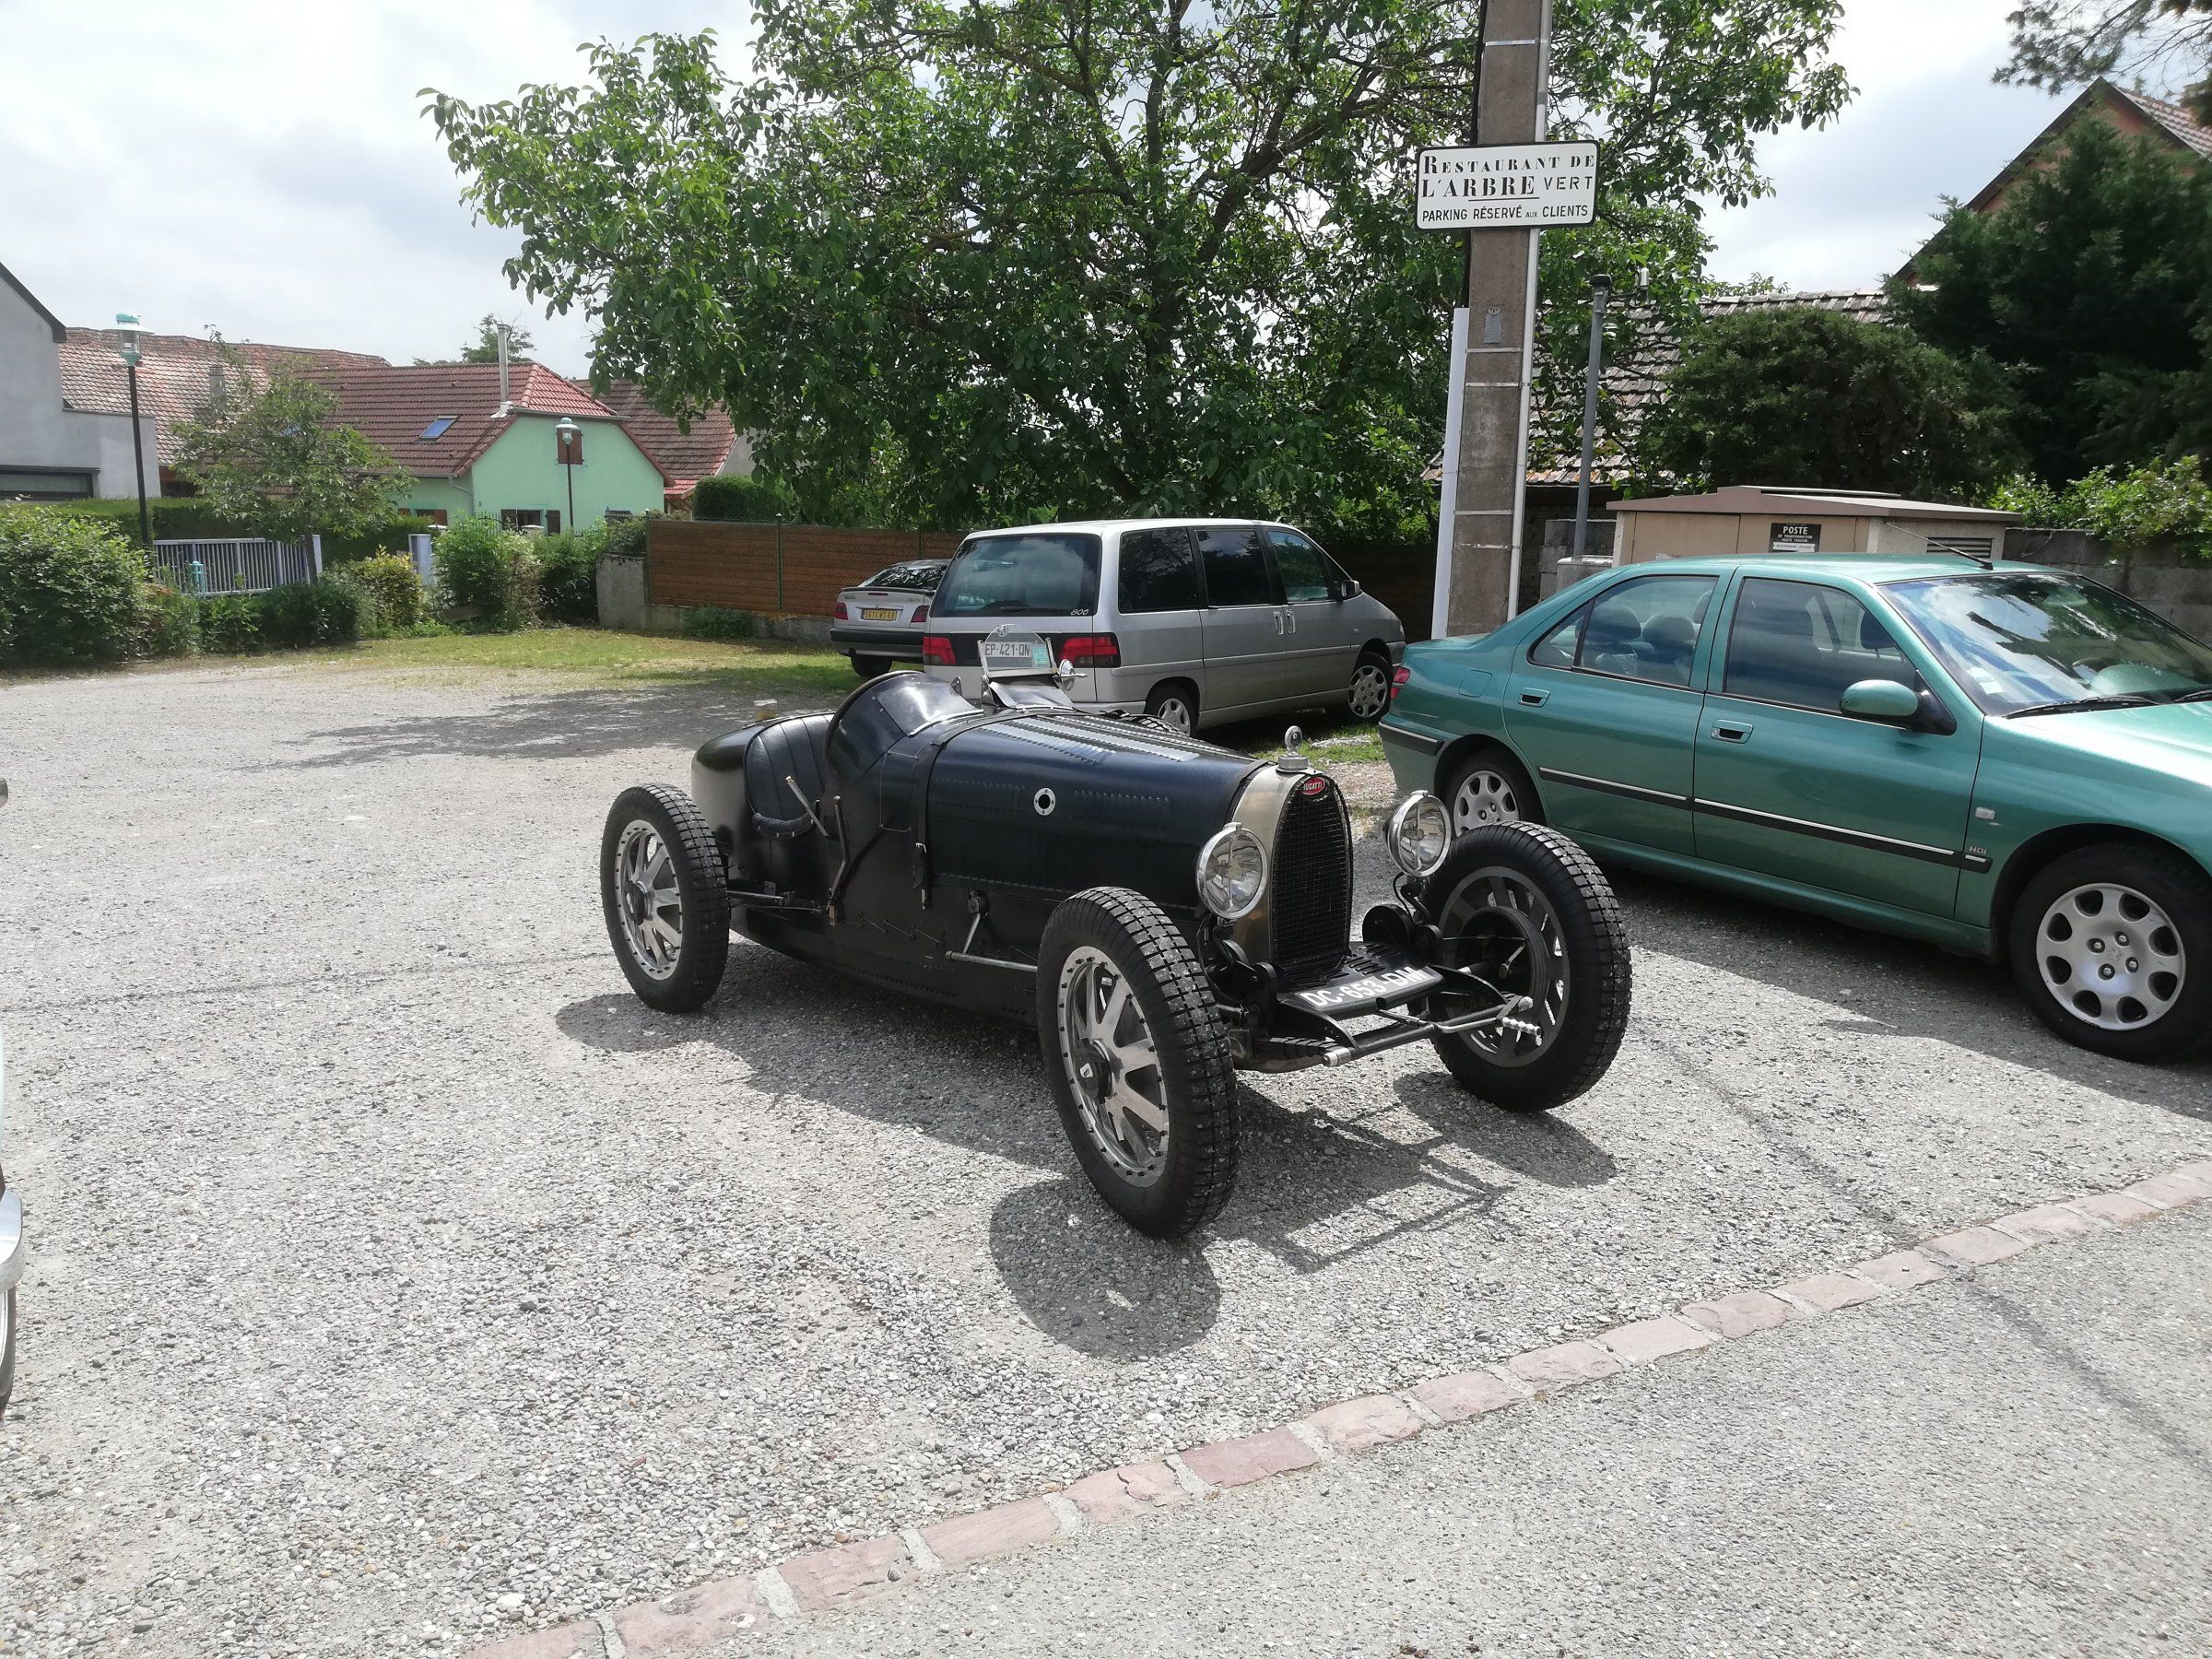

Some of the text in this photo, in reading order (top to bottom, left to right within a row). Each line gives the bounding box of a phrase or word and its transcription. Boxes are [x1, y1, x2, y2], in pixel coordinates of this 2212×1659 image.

[1570, 155, 1594, 169] DE
[1421, 175, 1593, 198] L'ARBRE VERT
[1422, 208, 1468, 222] PARKING
[1473, 205, 1522, 220] RÉSERVÉ
[1542, 205, 1588, 218] CLIENTS
[1783, 526, 1808, 535] POSTE
